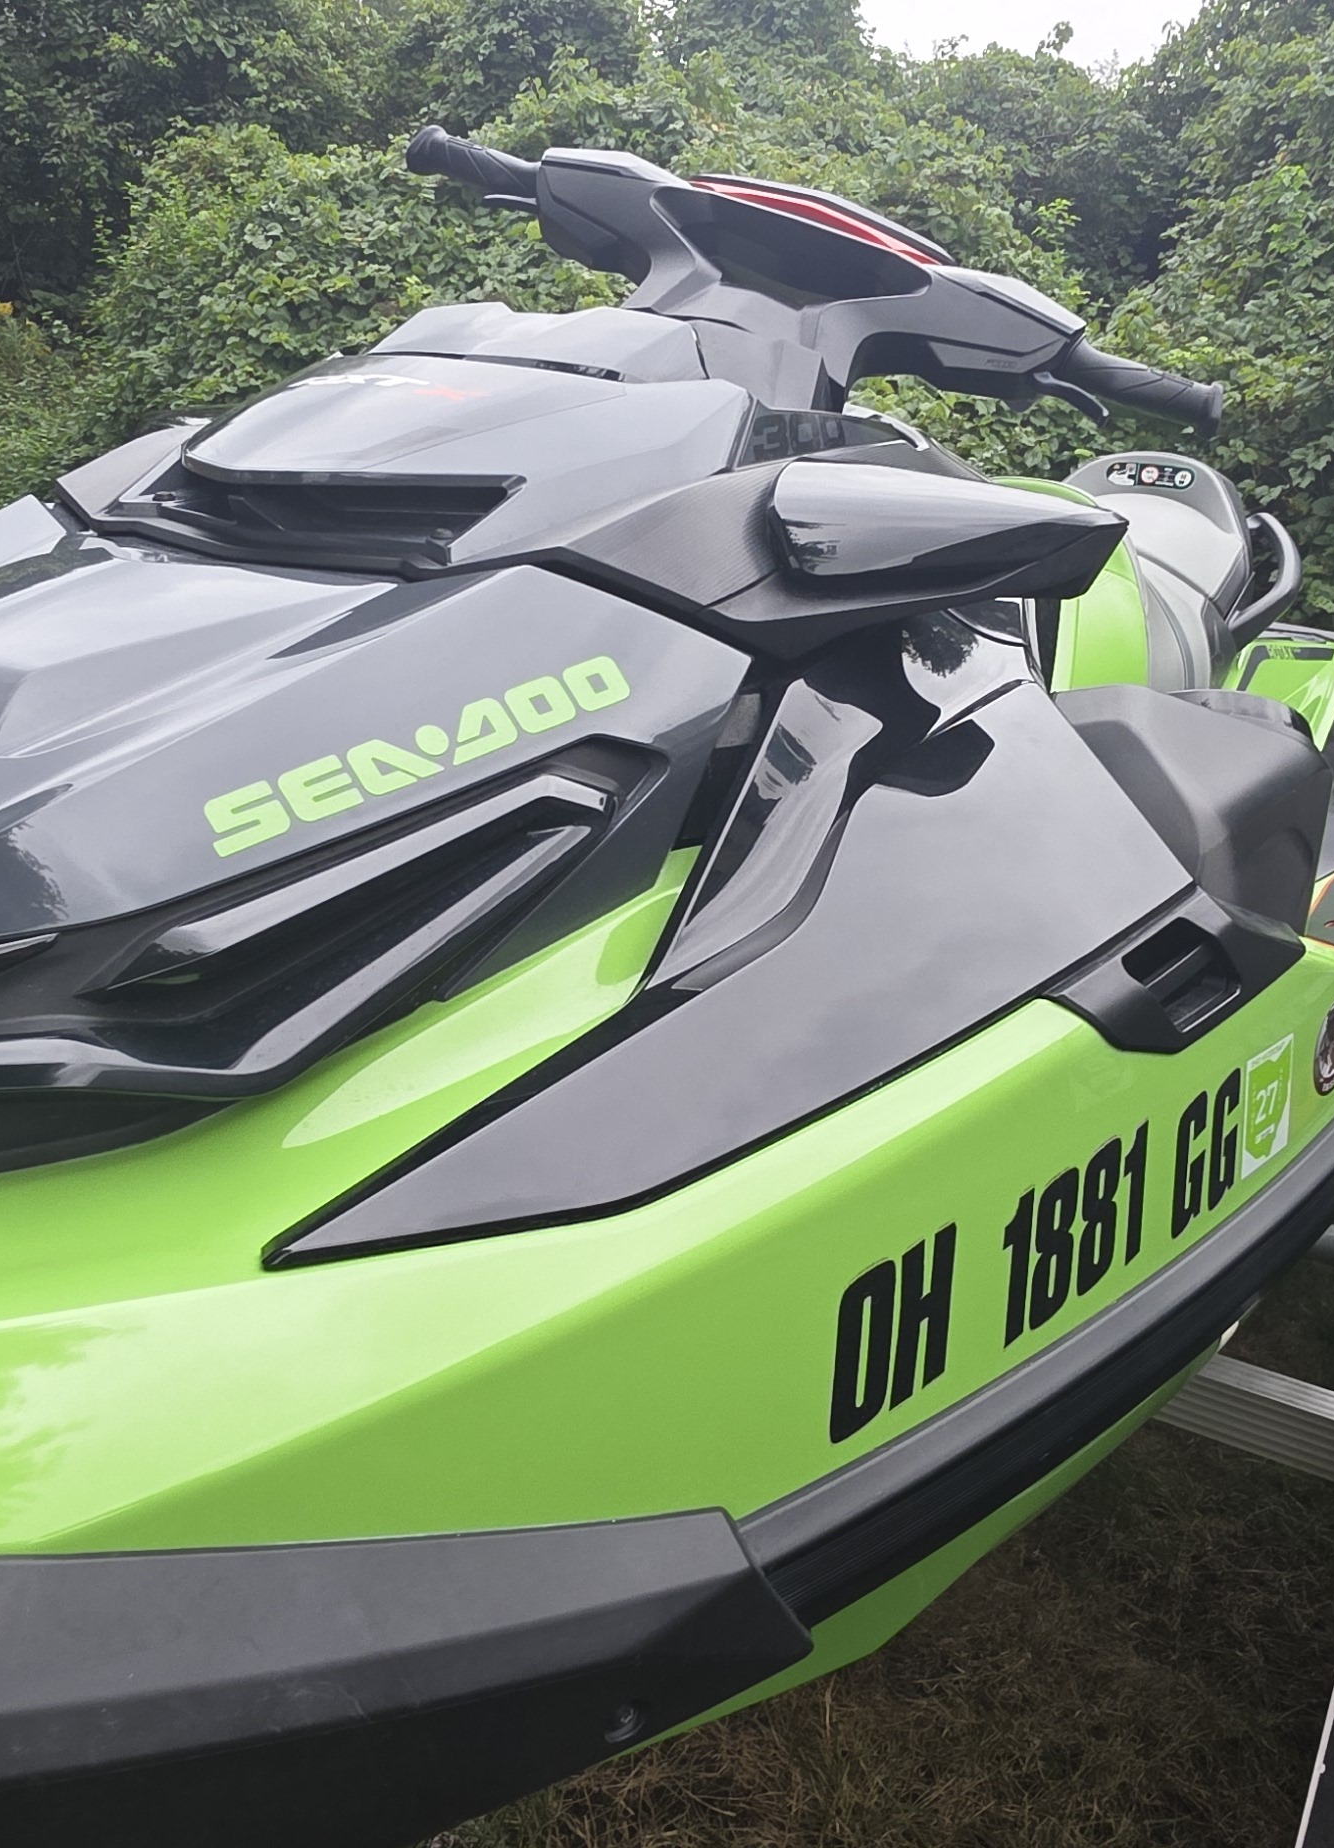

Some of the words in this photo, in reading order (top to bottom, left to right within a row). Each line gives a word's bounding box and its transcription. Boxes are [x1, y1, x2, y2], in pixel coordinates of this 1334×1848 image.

[1254, 1080, 1279, 1125] 27
[829, 1222, 957, 1446] OH
[1002, 1118, 1149, 1351] 1881
[1170, 1066, 1241, 1240] GG
